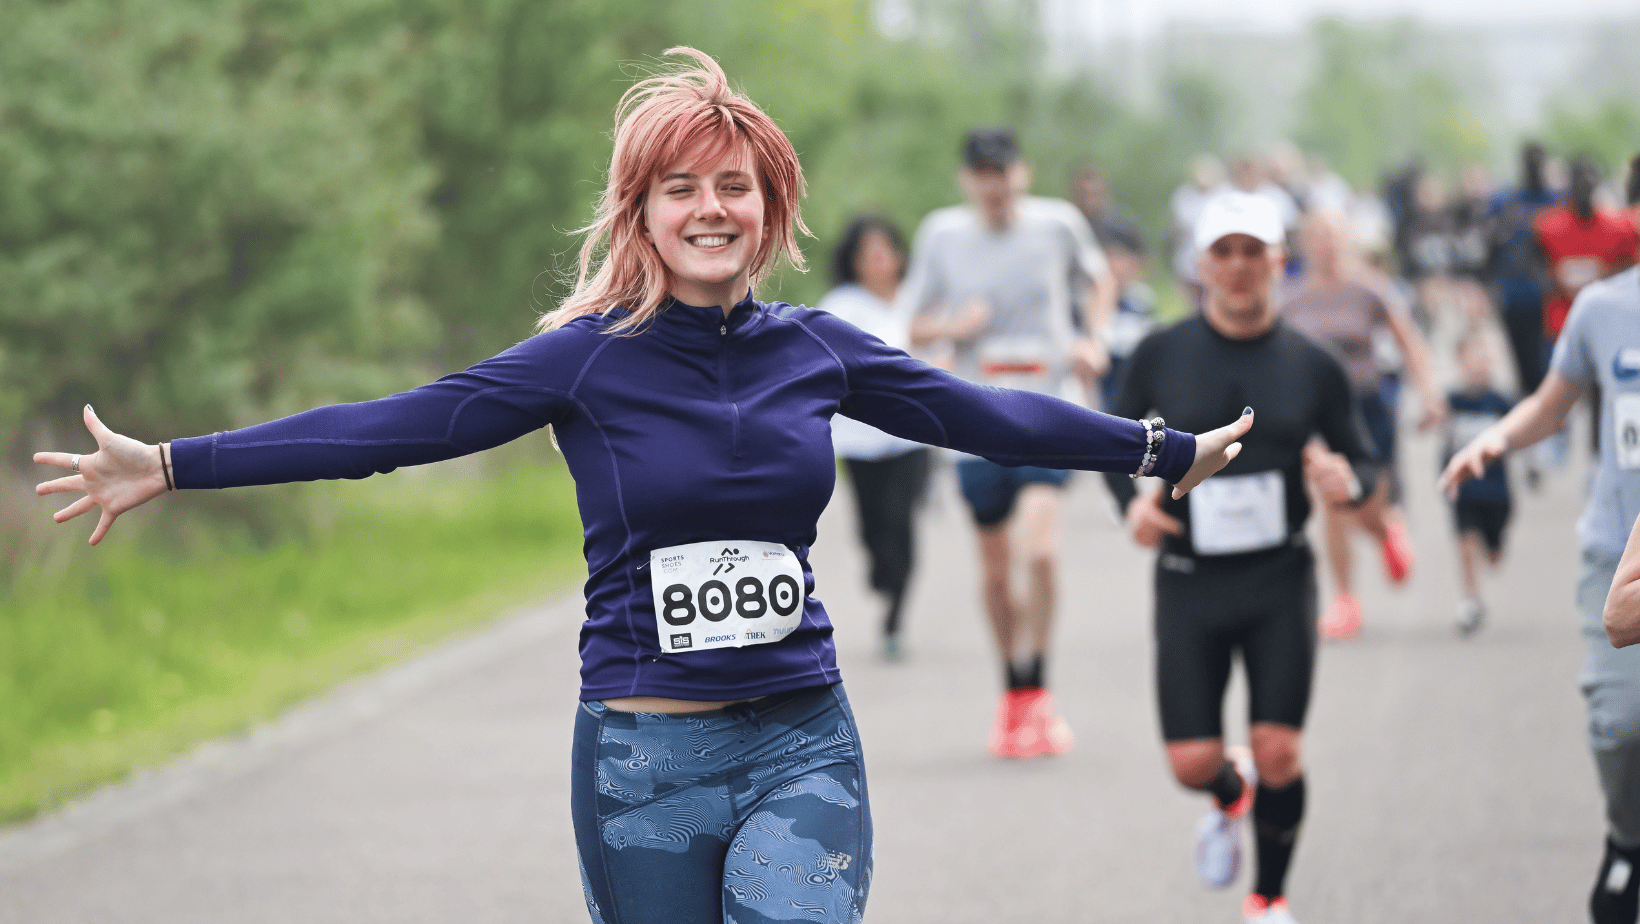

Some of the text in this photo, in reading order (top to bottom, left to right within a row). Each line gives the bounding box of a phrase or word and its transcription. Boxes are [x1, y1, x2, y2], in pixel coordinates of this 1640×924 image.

[661, 555, 684, 563] SPORTS
[709, 555, 750, 564] RunThrough
[662, 561, 682, 569] SHOES
[662, 574, 800, 626] 8080
[704, 633, 737, 643] BROOKS
[745, 631, 766, 639] TREK
